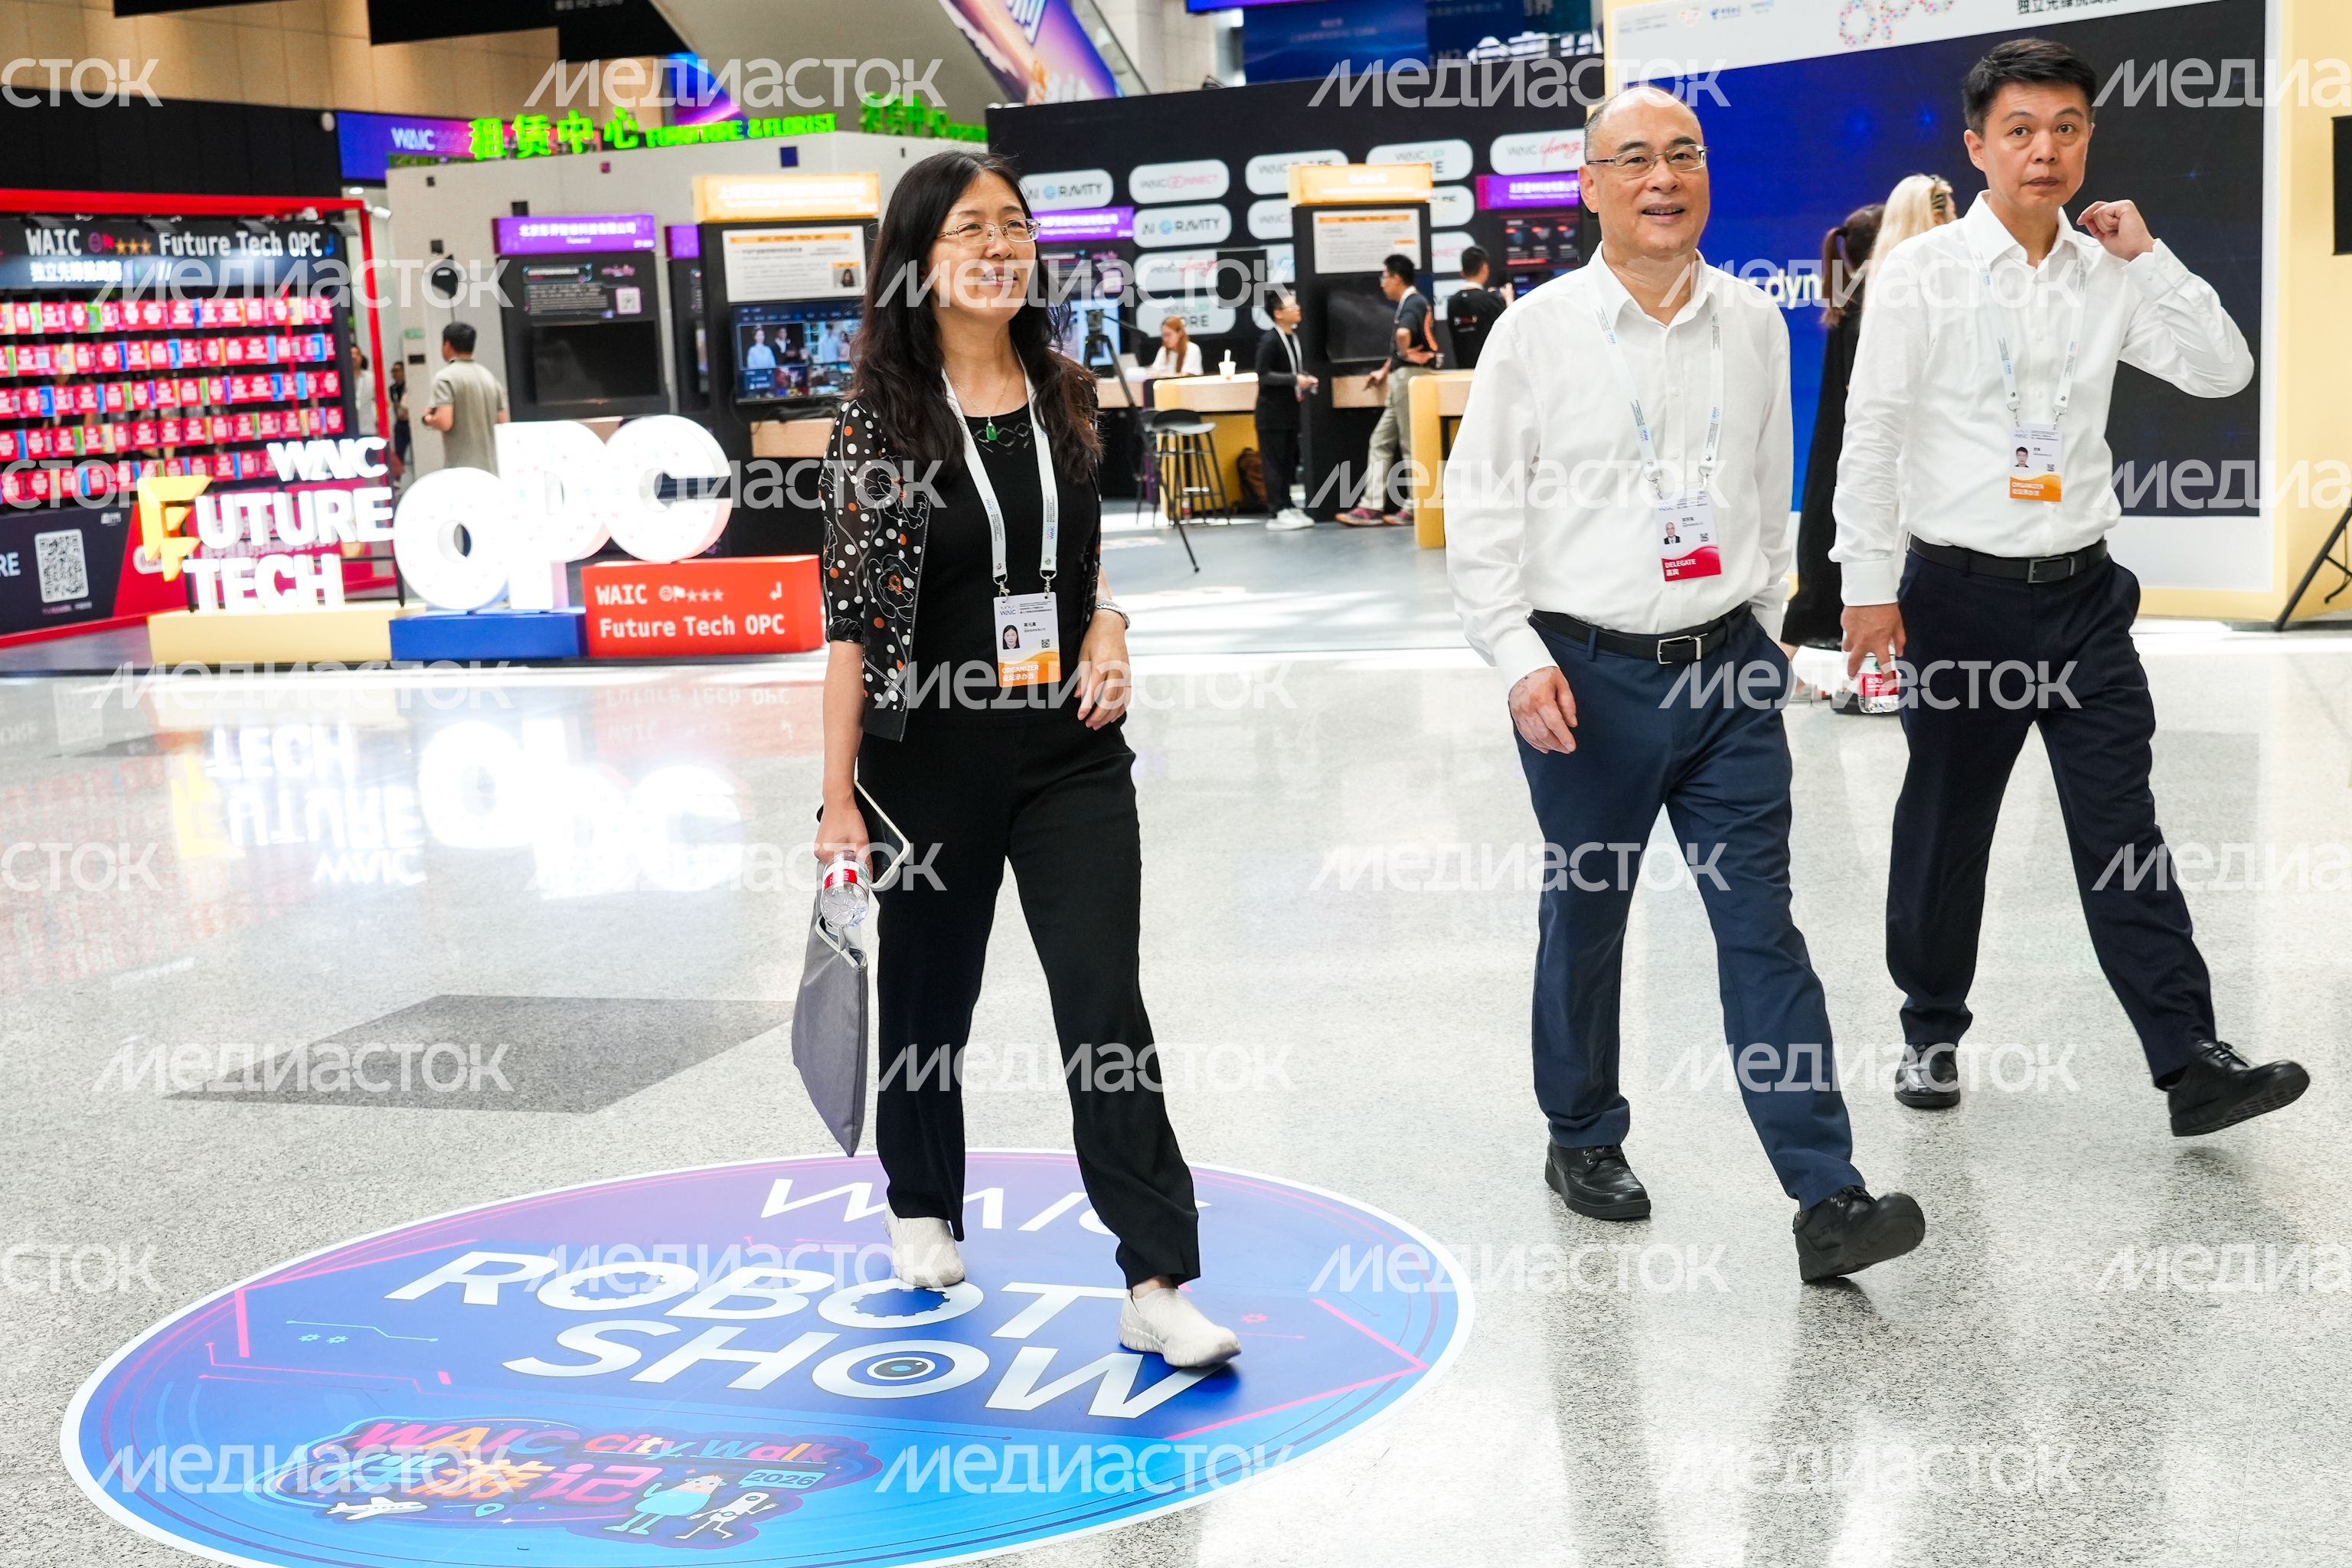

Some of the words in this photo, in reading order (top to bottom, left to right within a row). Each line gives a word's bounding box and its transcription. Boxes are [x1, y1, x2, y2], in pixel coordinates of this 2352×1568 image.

[390, 127, 436, 151] WAIC
[468, 106, 639, 161] 租赁中心
[24, 227, 83, 256] WAIC
[158, 232, 232, 256] Future
[236, 230, 284, 256] Tech
[289, 231, 323, 256] OPC
[266, 437, 389, 482] WAIC
[137, 475, 394, 582] FUTURE
[394, 415, 733, 610] OPC
[1665, 559, 1697, 568] DELEGATE
[183, 553, 346, 610] TECH
[596, 584, 648, 606] WAIC
[599, 617, 677, 639] Future
[685, 615, 735, 637] Tech
[745, 613, 786, 635] OPC
[1000, 608, 1018, 616] WAIC
[1001, 664, 1039, 673] ORGANIZER
[385, 1251, 1127, 1338] ROBOT
[502, 1319, 1227, 1419] SHOW
[354, 1423, 580, 1455] WAIC
[582, 1433, 692, 1460] City
[700, 1436, 846, 1463] Walk
[746, 1471, 817, 1488] 2026
